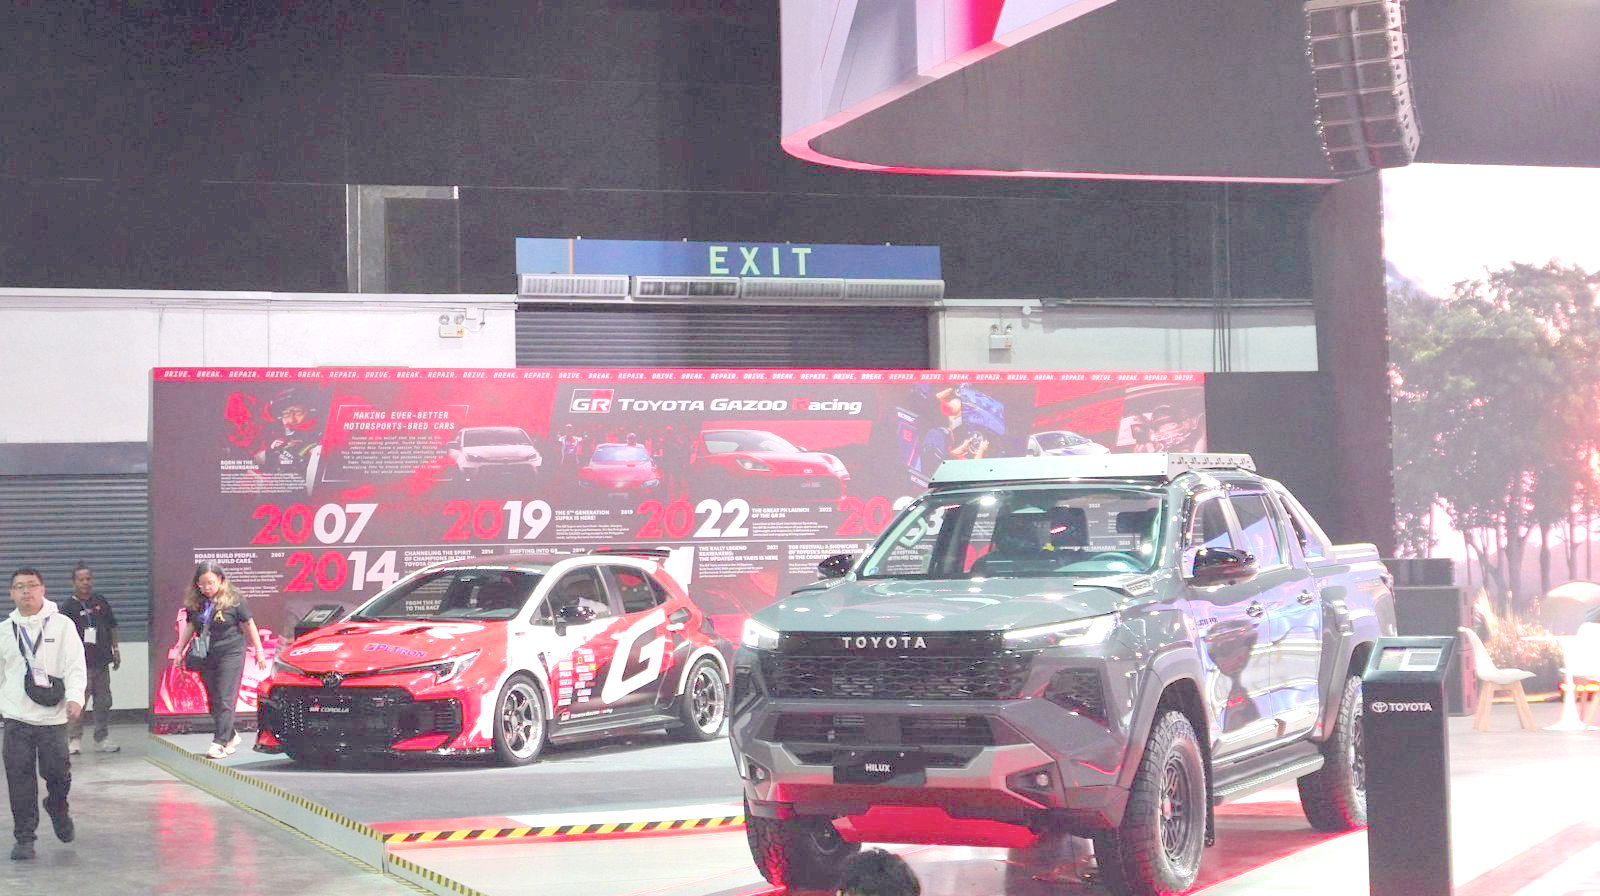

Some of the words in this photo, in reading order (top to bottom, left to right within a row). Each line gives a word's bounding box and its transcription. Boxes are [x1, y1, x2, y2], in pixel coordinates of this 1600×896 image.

[710, 245, 812, 275] EXIT
[572, 398, 610, 411] GR
[618, 398, 704, 411] TOYOTA
[710, 398, 787, 411] GAZOO
[791, 398, 862, 414] Racing
[390, 411, 449, 419] EVER-BETTER
[344, 422, 428, 430] MOTORSPORTS-BRED
[249, 503, 377, 544] 2007
[441, 499, 552, 541] 2019
[636, 498, 749, 539] 2022
[283, 550, 399, 592] 2014
[842, 637, 927, 649] TOYOTA
[376, 644, 426, 657] PETRON
[1388, 703, 1432, 711] TOYOTA
[865, 764, 890, 772] HILUX
